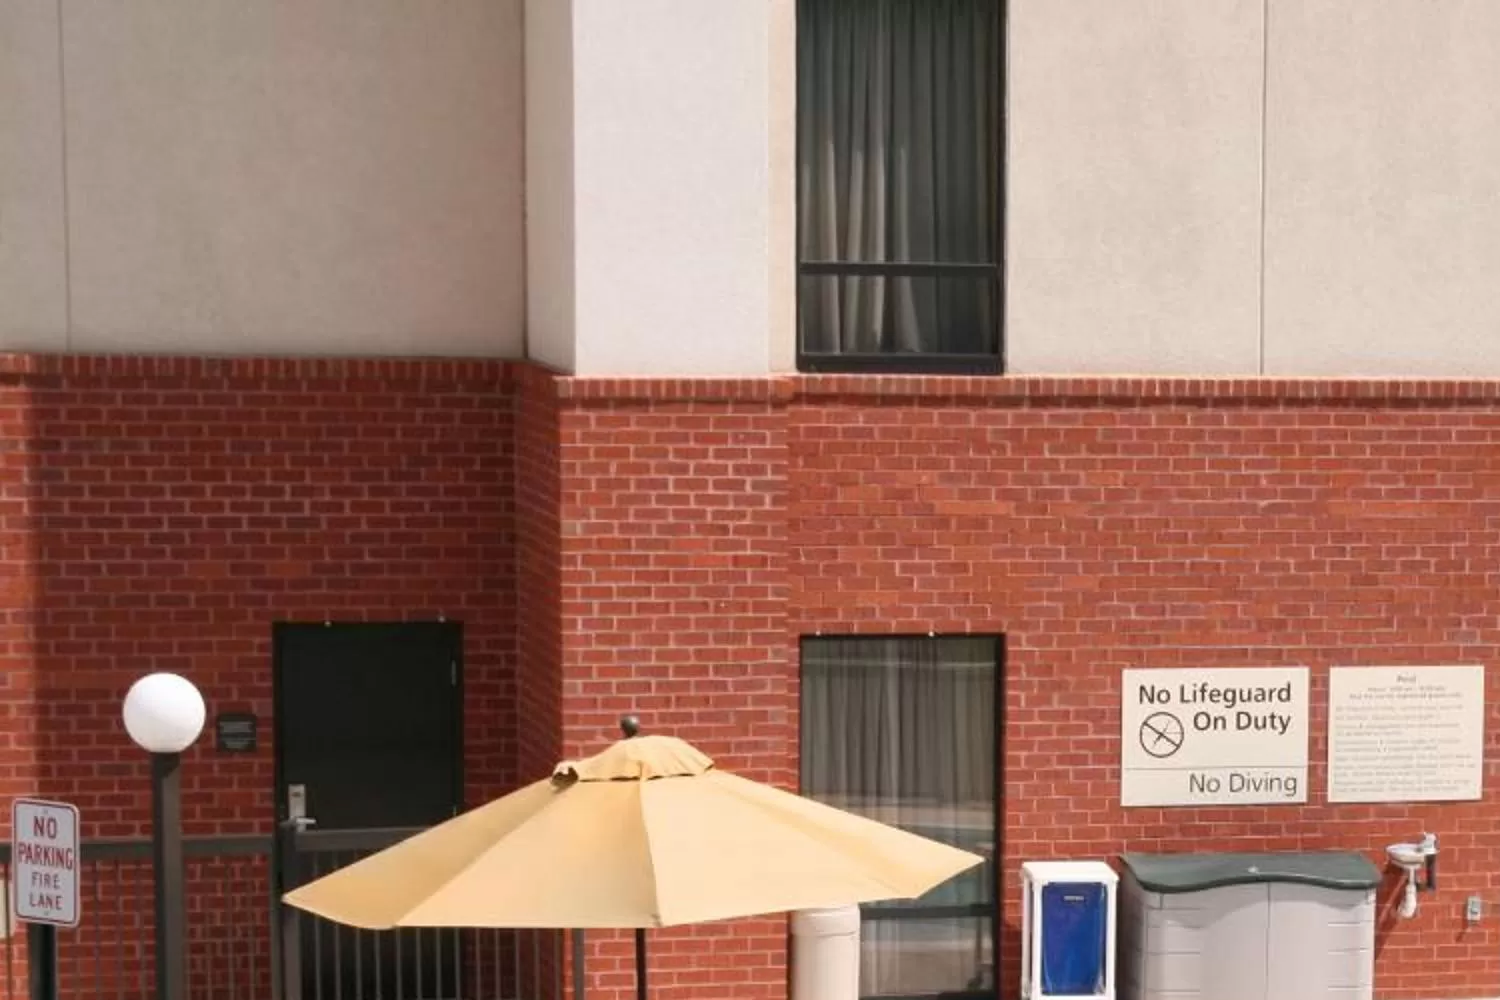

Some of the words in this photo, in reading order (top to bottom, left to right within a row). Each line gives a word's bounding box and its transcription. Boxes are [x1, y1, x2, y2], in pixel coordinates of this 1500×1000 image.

[1139, 684, 1171, 705] No
[1180, 682, 1291, 709] Lifeguard
[1193, 711, 1227, 731] On
[1236, 711, 1291, 735] Duty
[1189, 773, 1221, 793] No
[1229, 773, 1297, 797] Diving
[33, 815, 57, 839] NO
[18, 843, 73, 870] PARKING
[32, 871, 60, 889] FIRE
[29, 892, 63, 910] LANE
